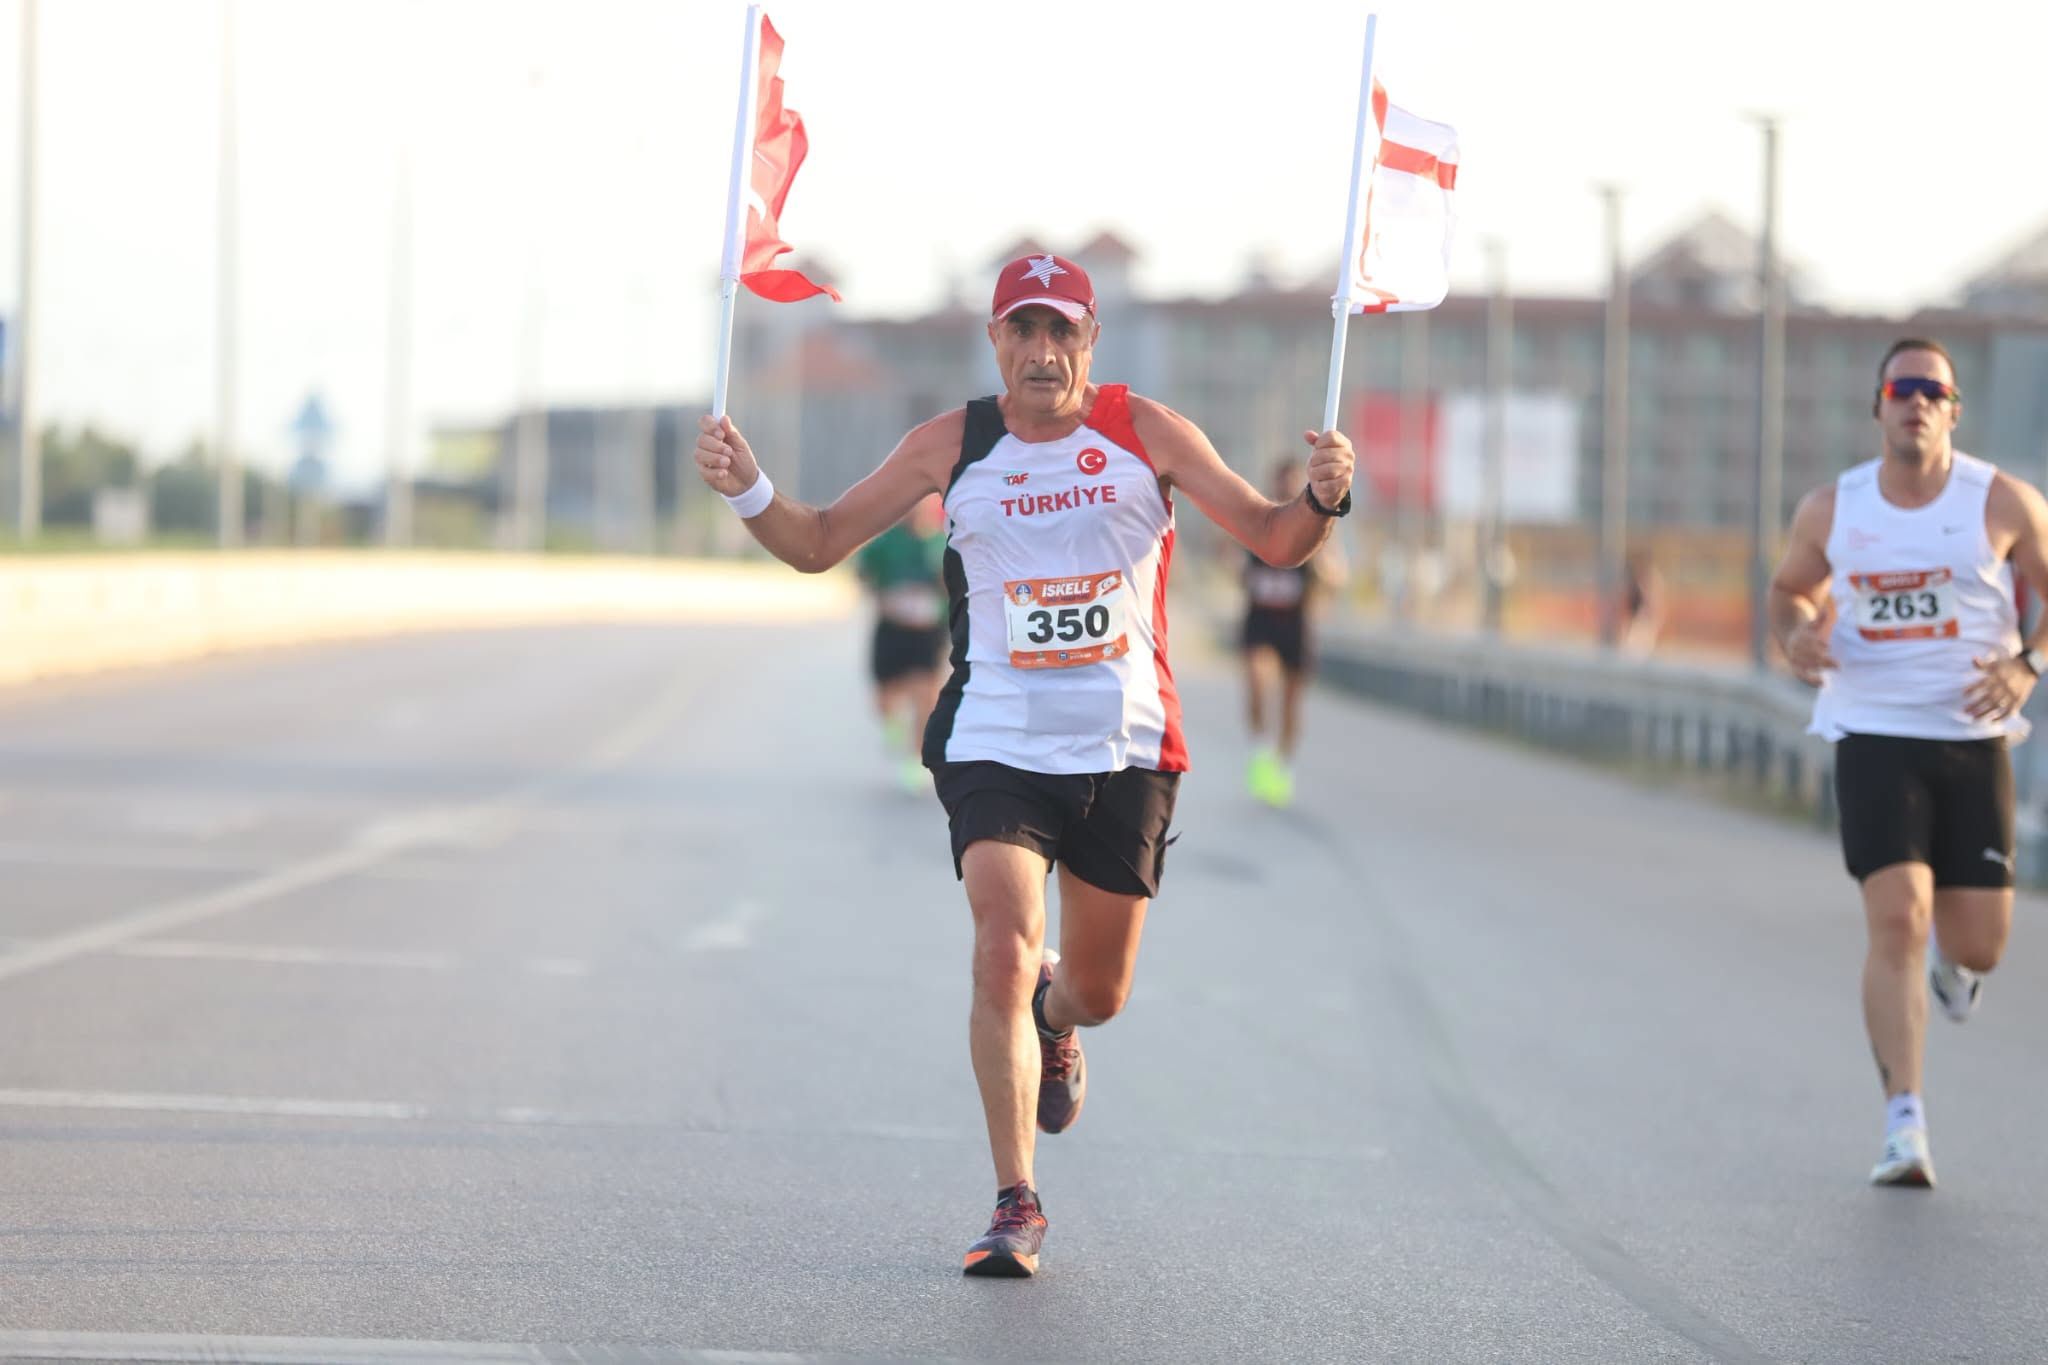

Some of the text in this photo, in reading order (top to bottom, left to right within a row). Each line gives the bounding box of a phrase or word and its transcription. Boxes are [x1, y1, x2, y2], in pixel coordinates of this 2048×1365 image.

[1003, 472, 1028, 485] TAF
[999, 485, 1117, 517] TÜRKİYE
[1869, 592, 1939, 622] 263
[1027, 604, 1109, 644] 350
